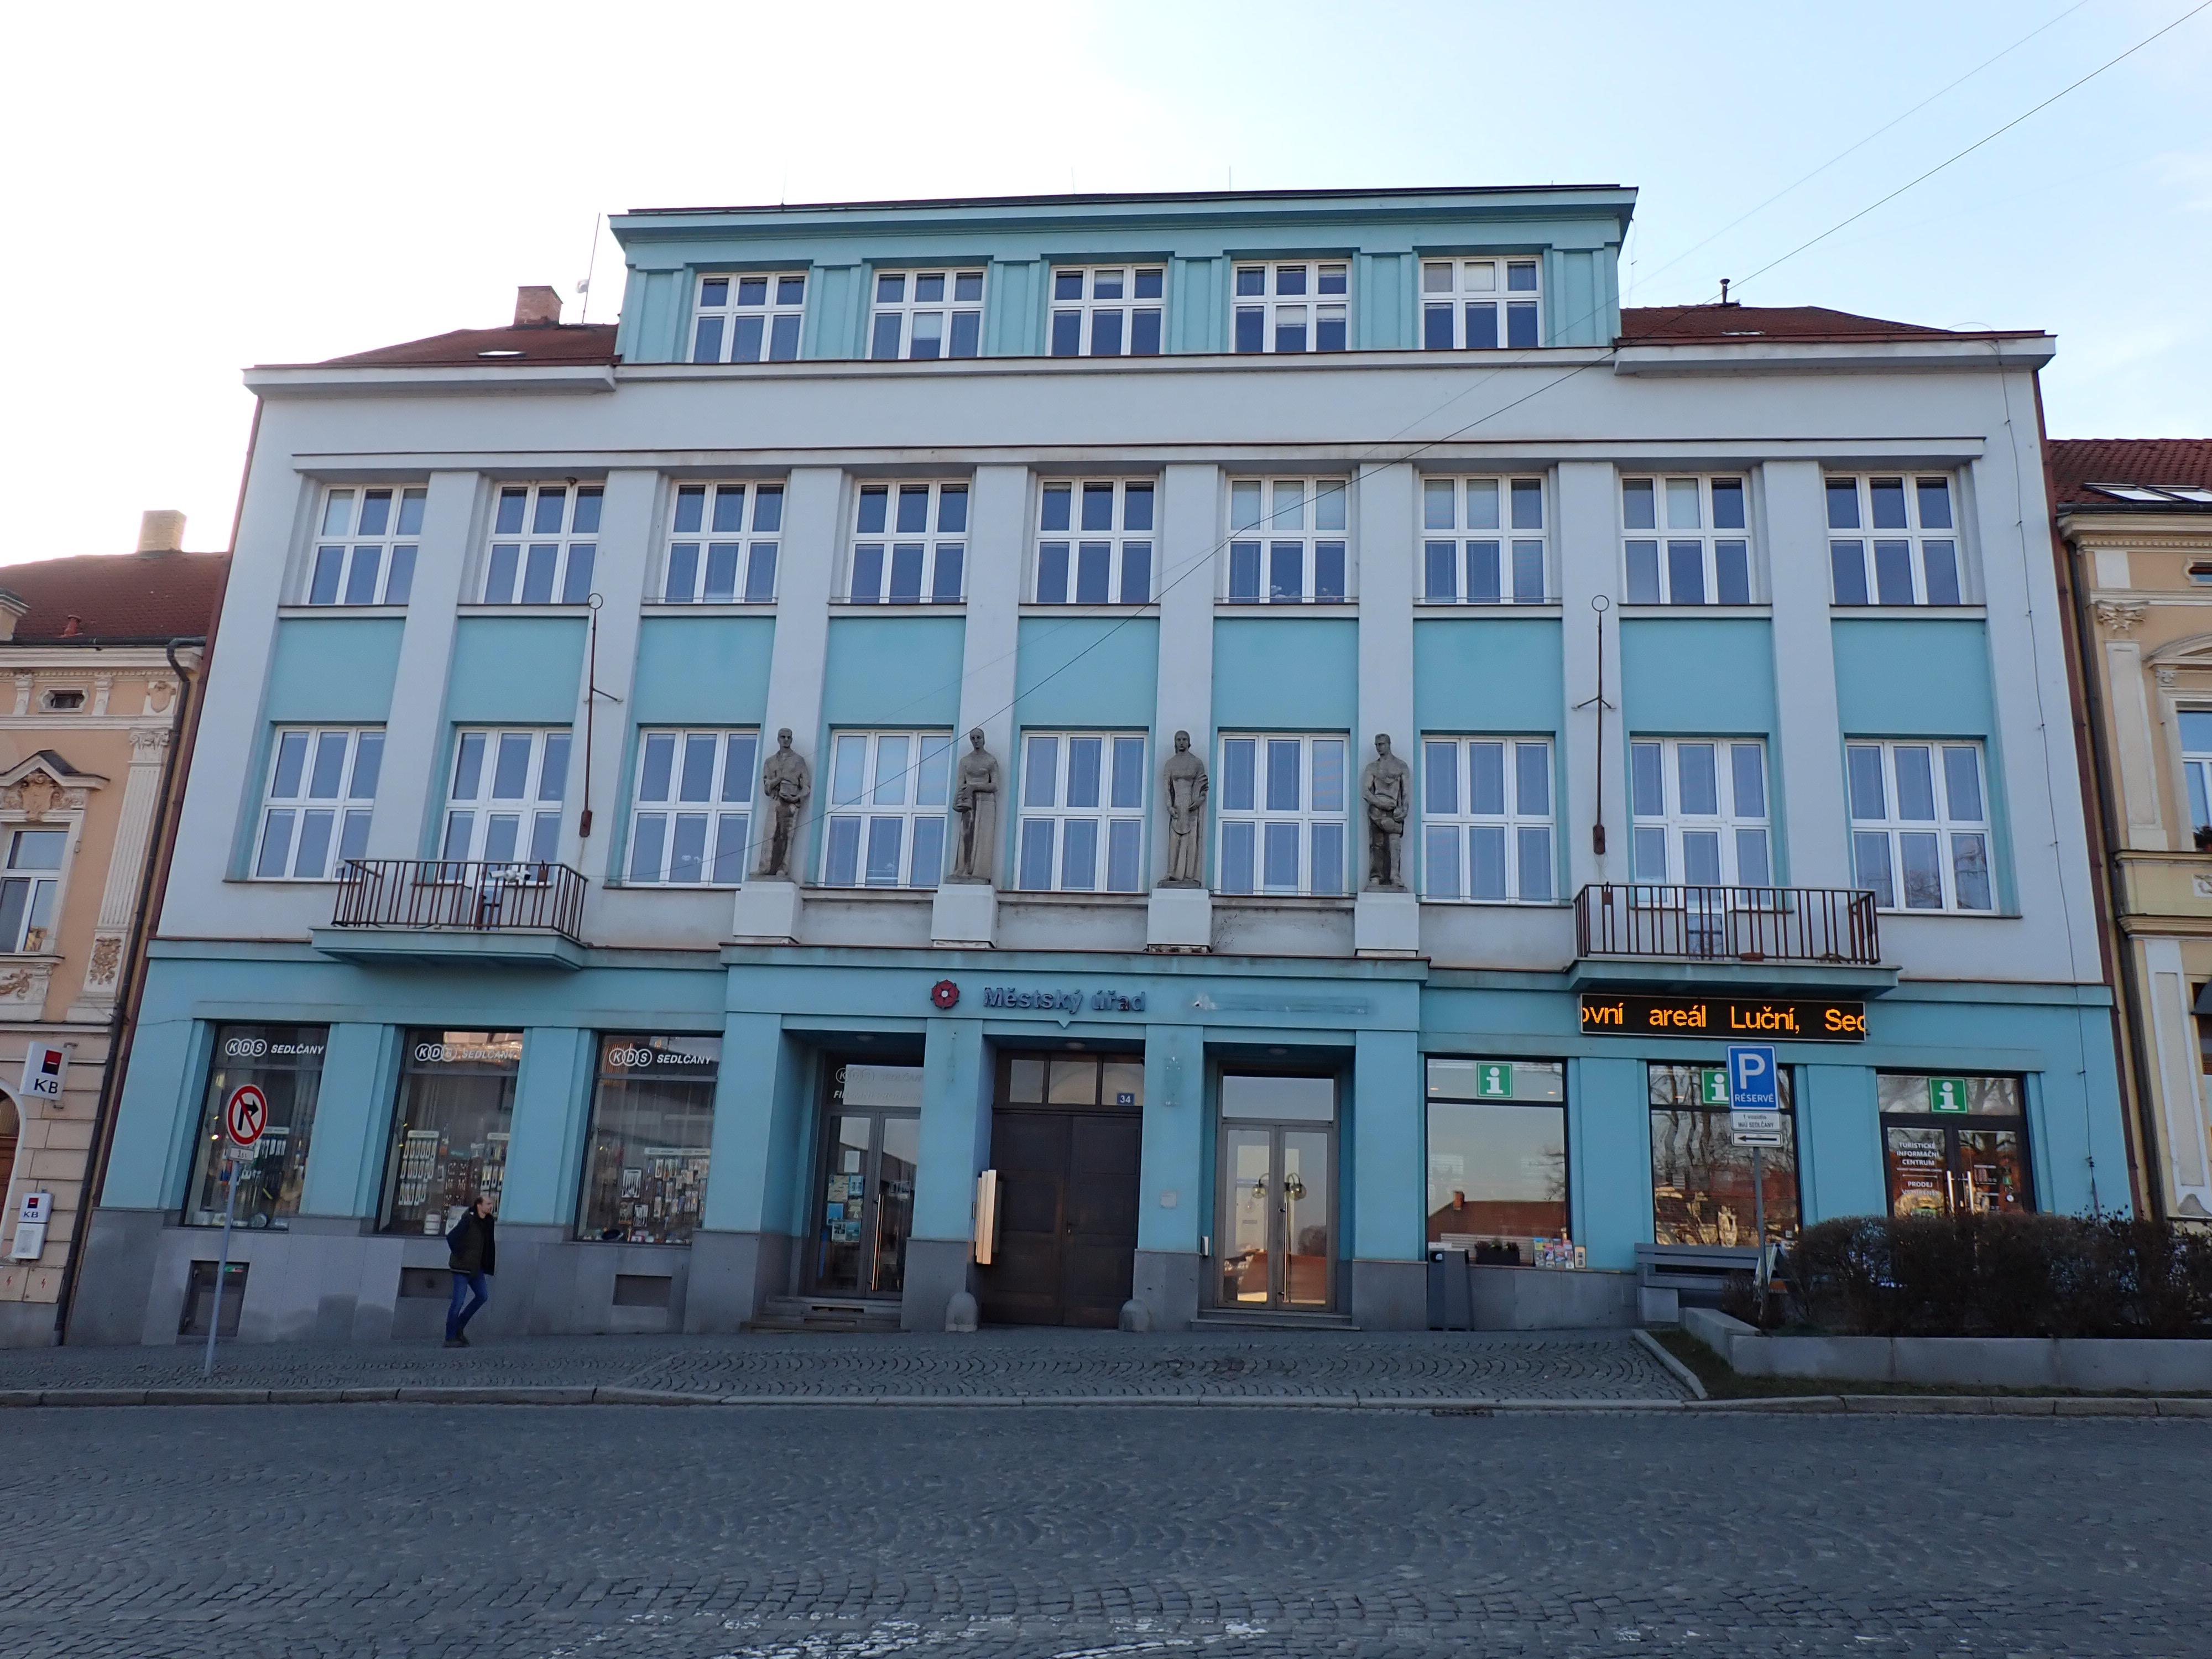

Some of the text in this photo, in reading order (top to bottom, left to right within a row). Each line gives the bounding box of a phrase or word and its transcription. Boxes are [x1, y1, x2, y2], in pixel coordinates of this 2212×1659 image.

[983, 987, 1146, 1014] Městský úřad
[1650, 1005, 1707, 1027] areál
[1731, 1006, 1799, 1034] Luční,
[227, 1040, 324, 1055] KDS SEDLČANY
[611, 1050, 711, 1065] KDS SEDLČANY
[1738, 1053, 1765, 1089] P
[34, 1079, 58, 1093] KB
[1120, 1095, 1131, 1103] 34
[1735, 1093, 1775, 1102] RÉSERVÉ
